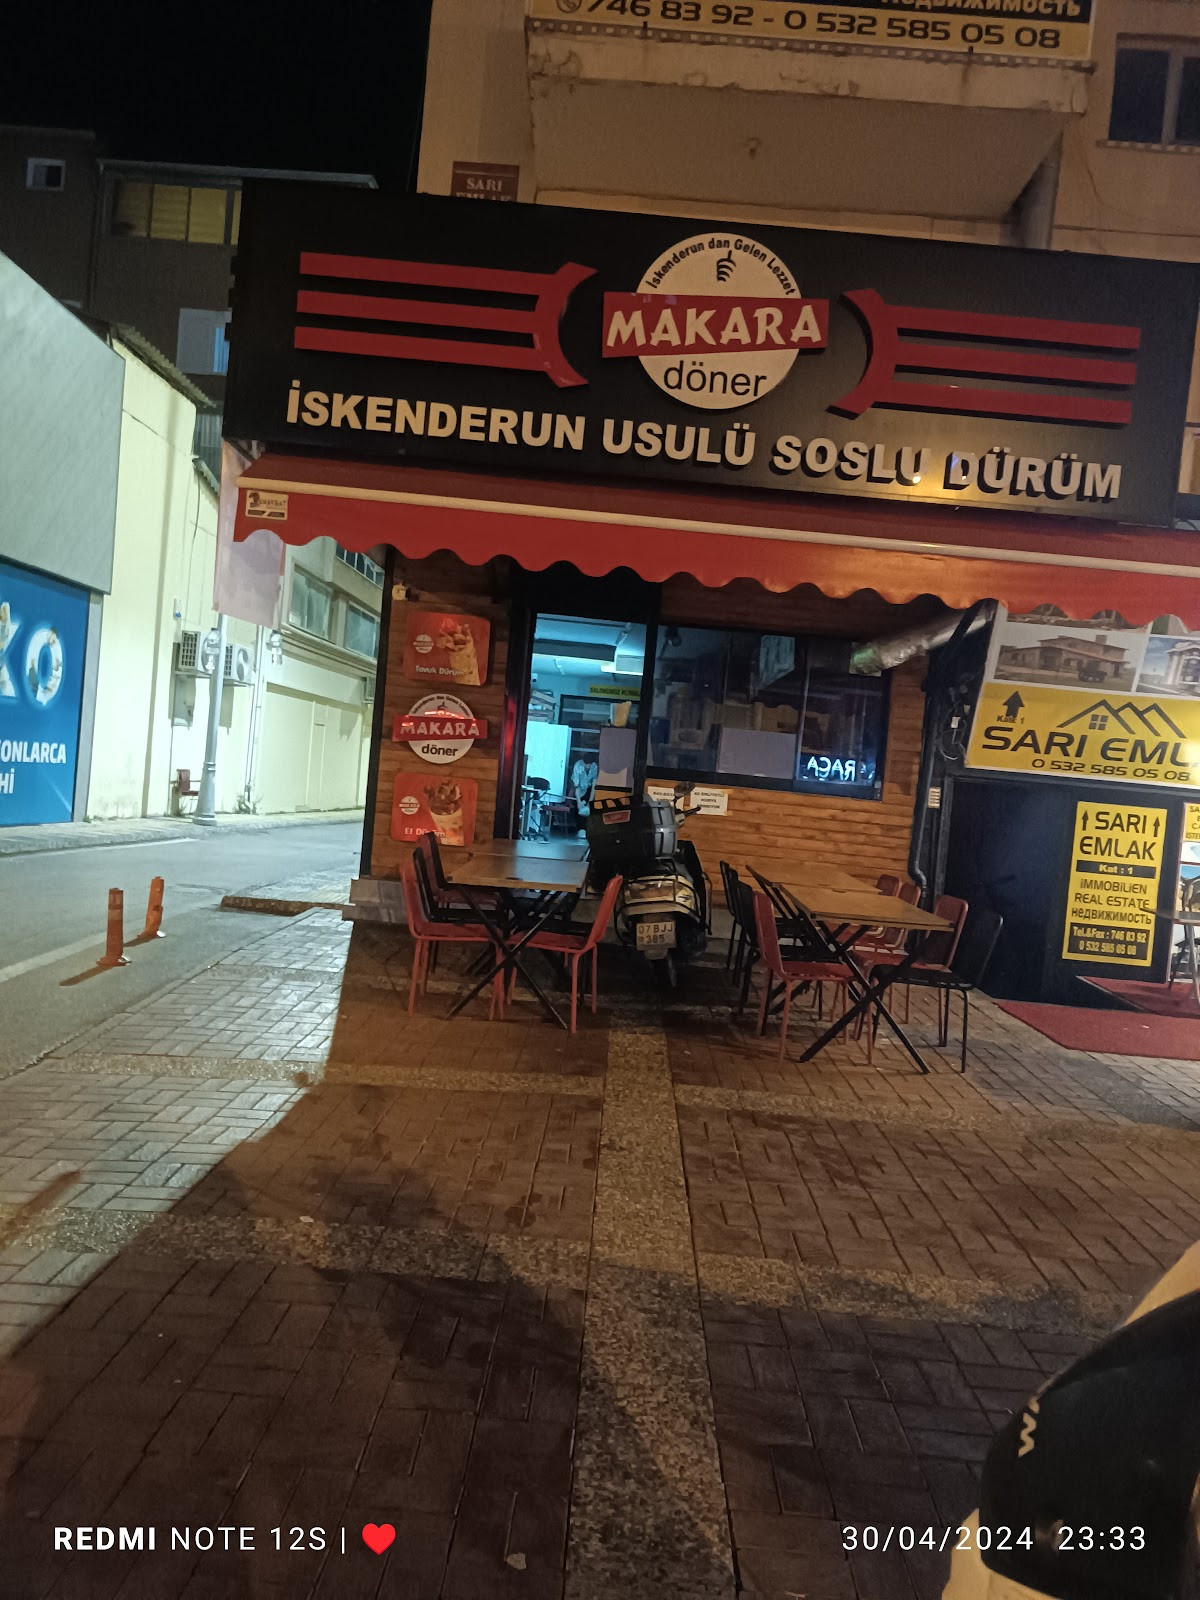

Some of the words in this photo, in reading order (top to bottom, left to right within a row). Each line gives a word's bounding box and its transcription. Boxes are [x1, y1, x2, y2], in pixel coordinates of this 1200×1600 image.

[660, 1, 702, 21] 83
[711, 5, 754, 26] 92
[784, 10, 807, 29] 0
[816, 12, 877, 36] 532
[887, 18, 951, 41] 585
[961, 23, 1004, 45] 05
[1014, 27, 1061, 49] 08
[466, 177, 503, 192] SARI
[708, 237, 731, 249] dan
[734, 238, 768, 262] Gelen
[767, 257, 796, 295] Lezzet
[606, 304, 822, 347] MAKARA
[663, 360, 768, 397] döner
[286, 379, 587, 451] İSKENDERUN
[602, 418, 757, 466] USULÜ
[772, 434, 932, 485] SOSLU
[947, 446, 1123, 501] DÜRÜM
[400, 720, 480, 736] MAKARA
[0, 740, 67, 765] ONLARCA
[421, 743, 459, 757] döner
[981, 725, 1088, 758] SARI
[1100, 737, 1200, 769] EML
[1031, 758, 1045, 769] 0
[1050, 760, 1084, 773] 532
[1090, 763, 1128, 776] 585
[1133, 767, 1159, 779] 05
[1163, 770, 1191, 782] 08
[1094, 811, 1147, 834] SARI
[1079, 836, 1157, 861] EMLAK
[1098, 863, 1119, 874] Kat
[1074, 893, 1103, 905] REAL
[1106, 895, 1150, 909] ESTATE
[1136, 932, 1147, 943] 92
